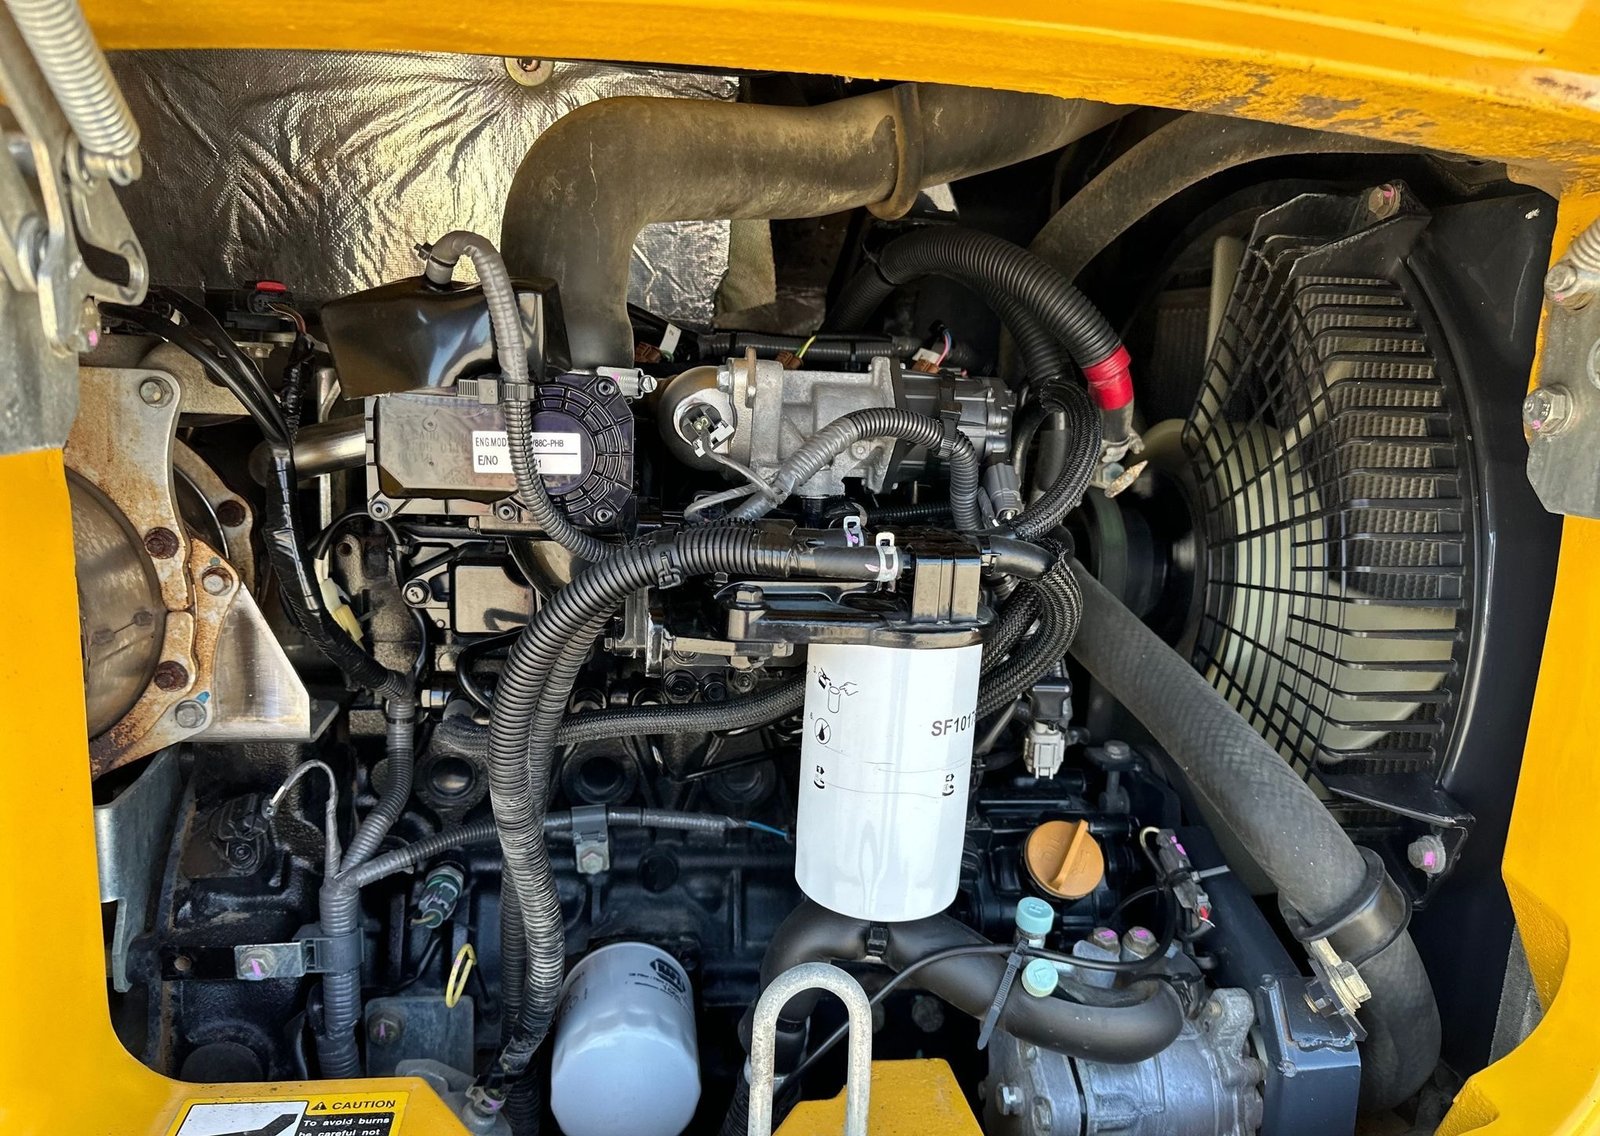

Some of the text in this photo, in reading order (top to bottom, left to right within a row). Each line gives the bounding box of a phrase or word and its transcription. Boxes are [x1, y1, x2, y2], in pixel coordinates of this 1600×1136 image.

[477, 455, 499, 466] E/NO
[332, 1100, 396, 1110] CAUTION
[322, 1118, 353, 1127] avoid
[358, 1117, 390, 1125] burns
